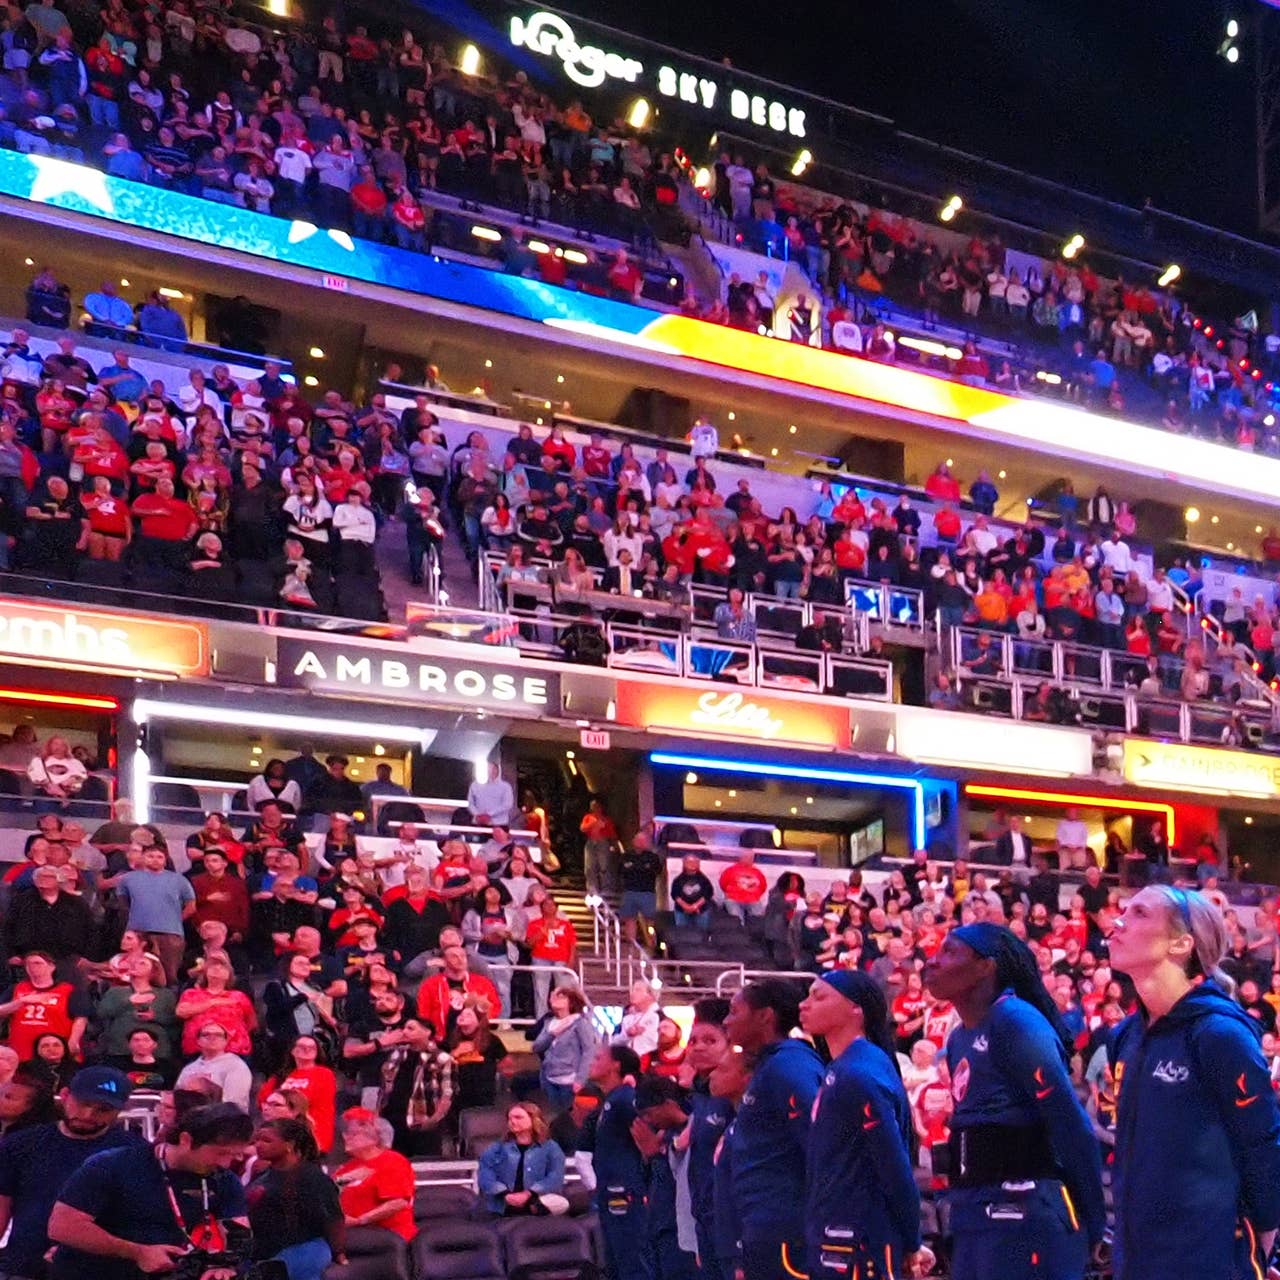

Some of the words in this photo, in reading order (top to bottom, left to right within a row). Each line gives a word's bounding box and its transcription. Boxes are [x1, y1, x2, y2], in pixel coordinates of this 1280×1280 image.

[510, 11, 643, 88] Kroger
[658, 66, 717, 109] SKY
[730, 89, 806, 138] DECK
[294, 651, 548, 704] AMBROSE
